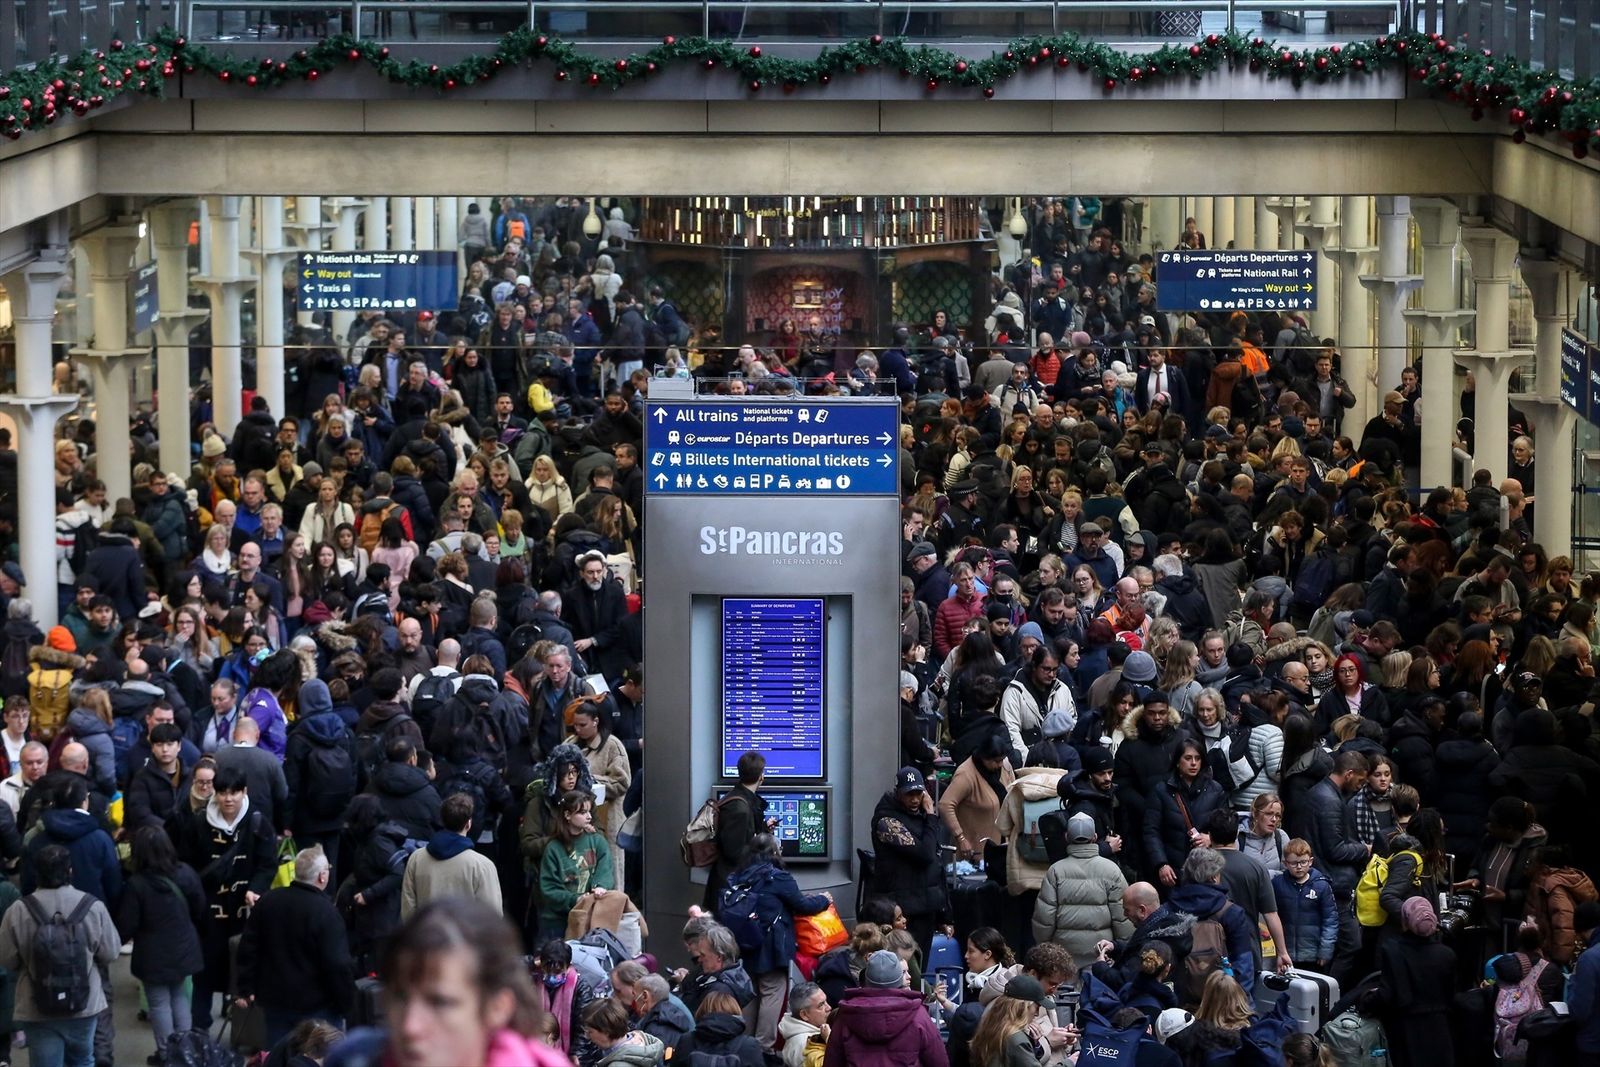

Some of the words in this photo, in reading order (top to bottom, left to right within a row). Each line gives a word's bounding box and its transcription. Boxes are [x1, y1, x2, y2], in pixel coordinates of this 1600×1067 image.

[316, 254, 353, 264] National
[355, 254, 371, 264] Rail
[1215, 253, 1248, 263] Départs
[1251, 254, 1298, 263] Departures
[317, 271, 335, 280] Way
[1244, 269, 1279, 277] National
[1282, 269, 1298, 277] Rail
[317, 284, 340, 292] Taxis
[1265, 284, 1282, 293] Way
[676, 409, 695, 422] All
[699, 409, 738, 422] trains
[735, 432, 789, 447] Départs
[793, 433, 870, 447] Departures
[686, 453, 729, 466] Billets
[733, 453, 820, 466] International
[824, 454, 870, 466] tickets
[1098, 1047, 1119, 1056] ESCP
